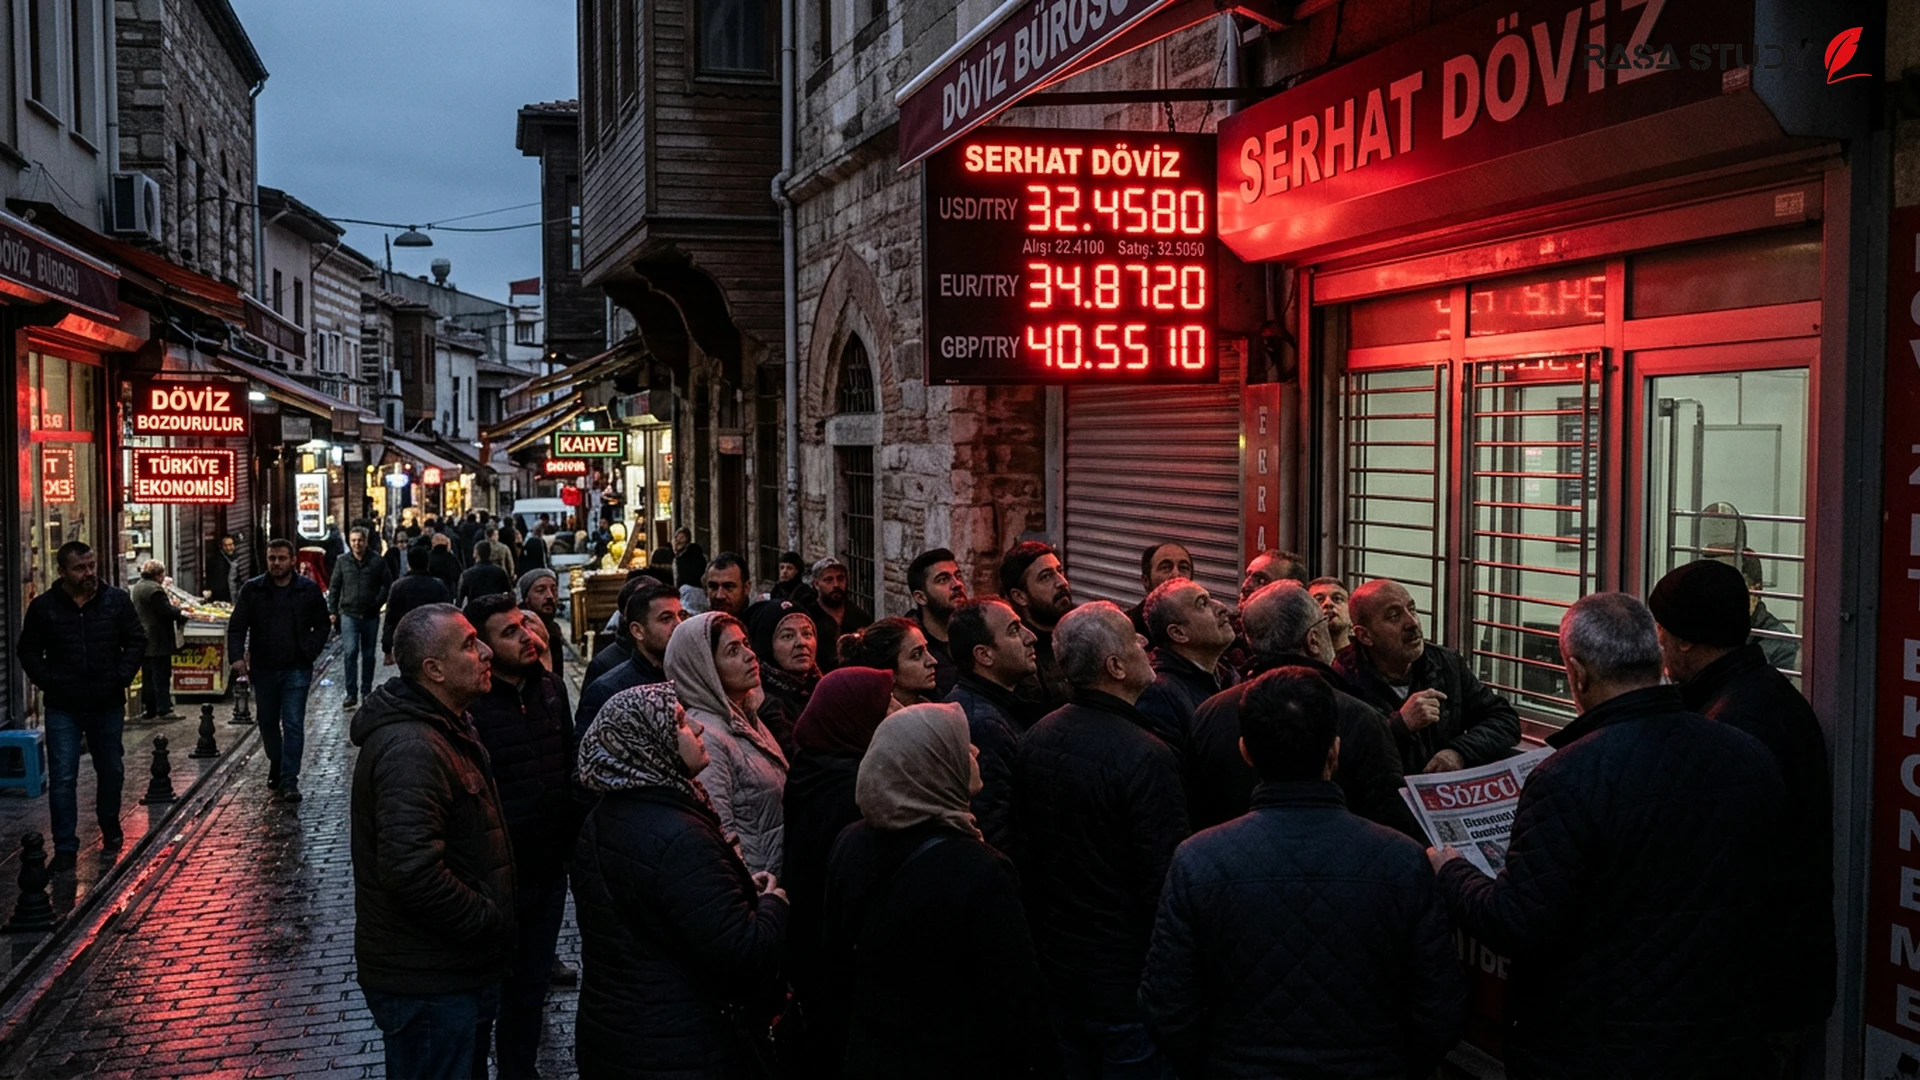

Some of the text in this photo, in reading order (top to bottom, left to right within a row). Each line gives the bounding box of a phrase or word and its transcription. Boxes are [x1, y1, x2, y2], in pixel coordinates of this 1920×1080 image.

[942, 40, 1007, 131] DÖVİZ
[1238, 0, 1670, 204] SERHAT DÖVİZ
[965, 143, 1180, 177] SERHAT DÖVİZ
[939, 185, 1204, 234] USD/TRY 32.4580
[0, 231, 31, 278] ÖVİZ
[1055, 239, 1105, 254] 22.4100
[940, 263, 1205, 309] EUR/TRY 34.8720
[941, 335, 1020, 359] GBP/TRY
[152, 385, 230, 412] DÖVİZ
[560, 436, 618, 453] KAHVE
[140, 476, 229, 496] EKONOMİSİ
